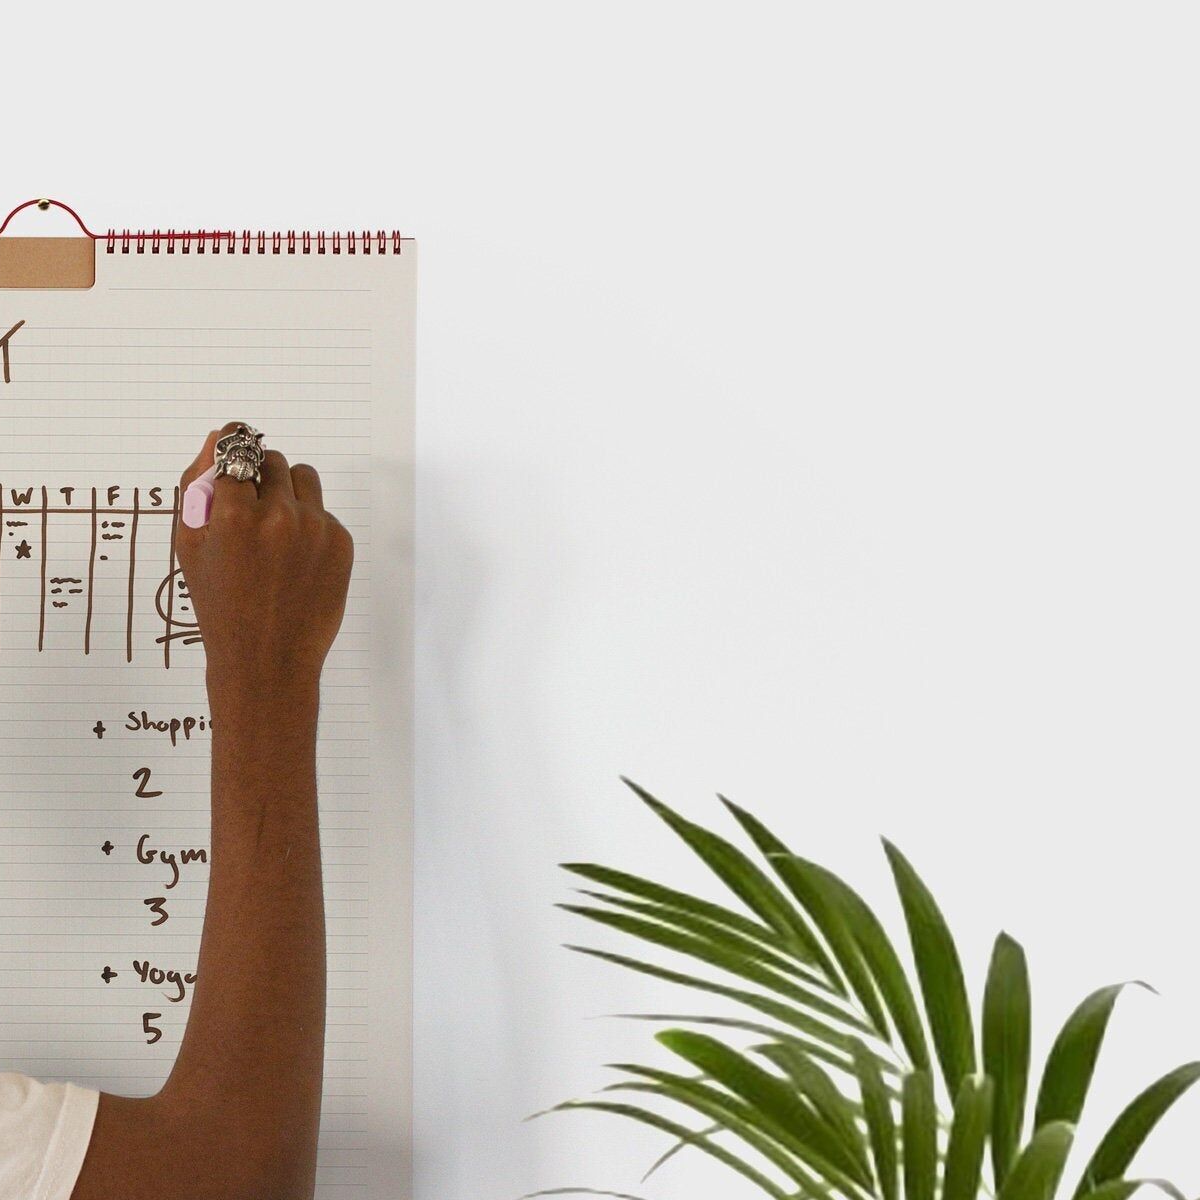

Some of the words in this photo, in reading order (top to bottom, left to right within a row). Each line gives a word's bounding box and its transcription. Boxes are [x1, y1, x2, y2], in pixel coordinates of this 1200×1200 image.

[11, 487, 33, 506] W
[60, 487, 75, 505] T
[107, 485, 120, 506] F
[149, 487, 162, 506] S
[132, 767, 164, 799] 2
[136, 834, 208, 890] Gym
[143, 897, 169, 927] 3
[142, 1012, 163, 1045] 5
